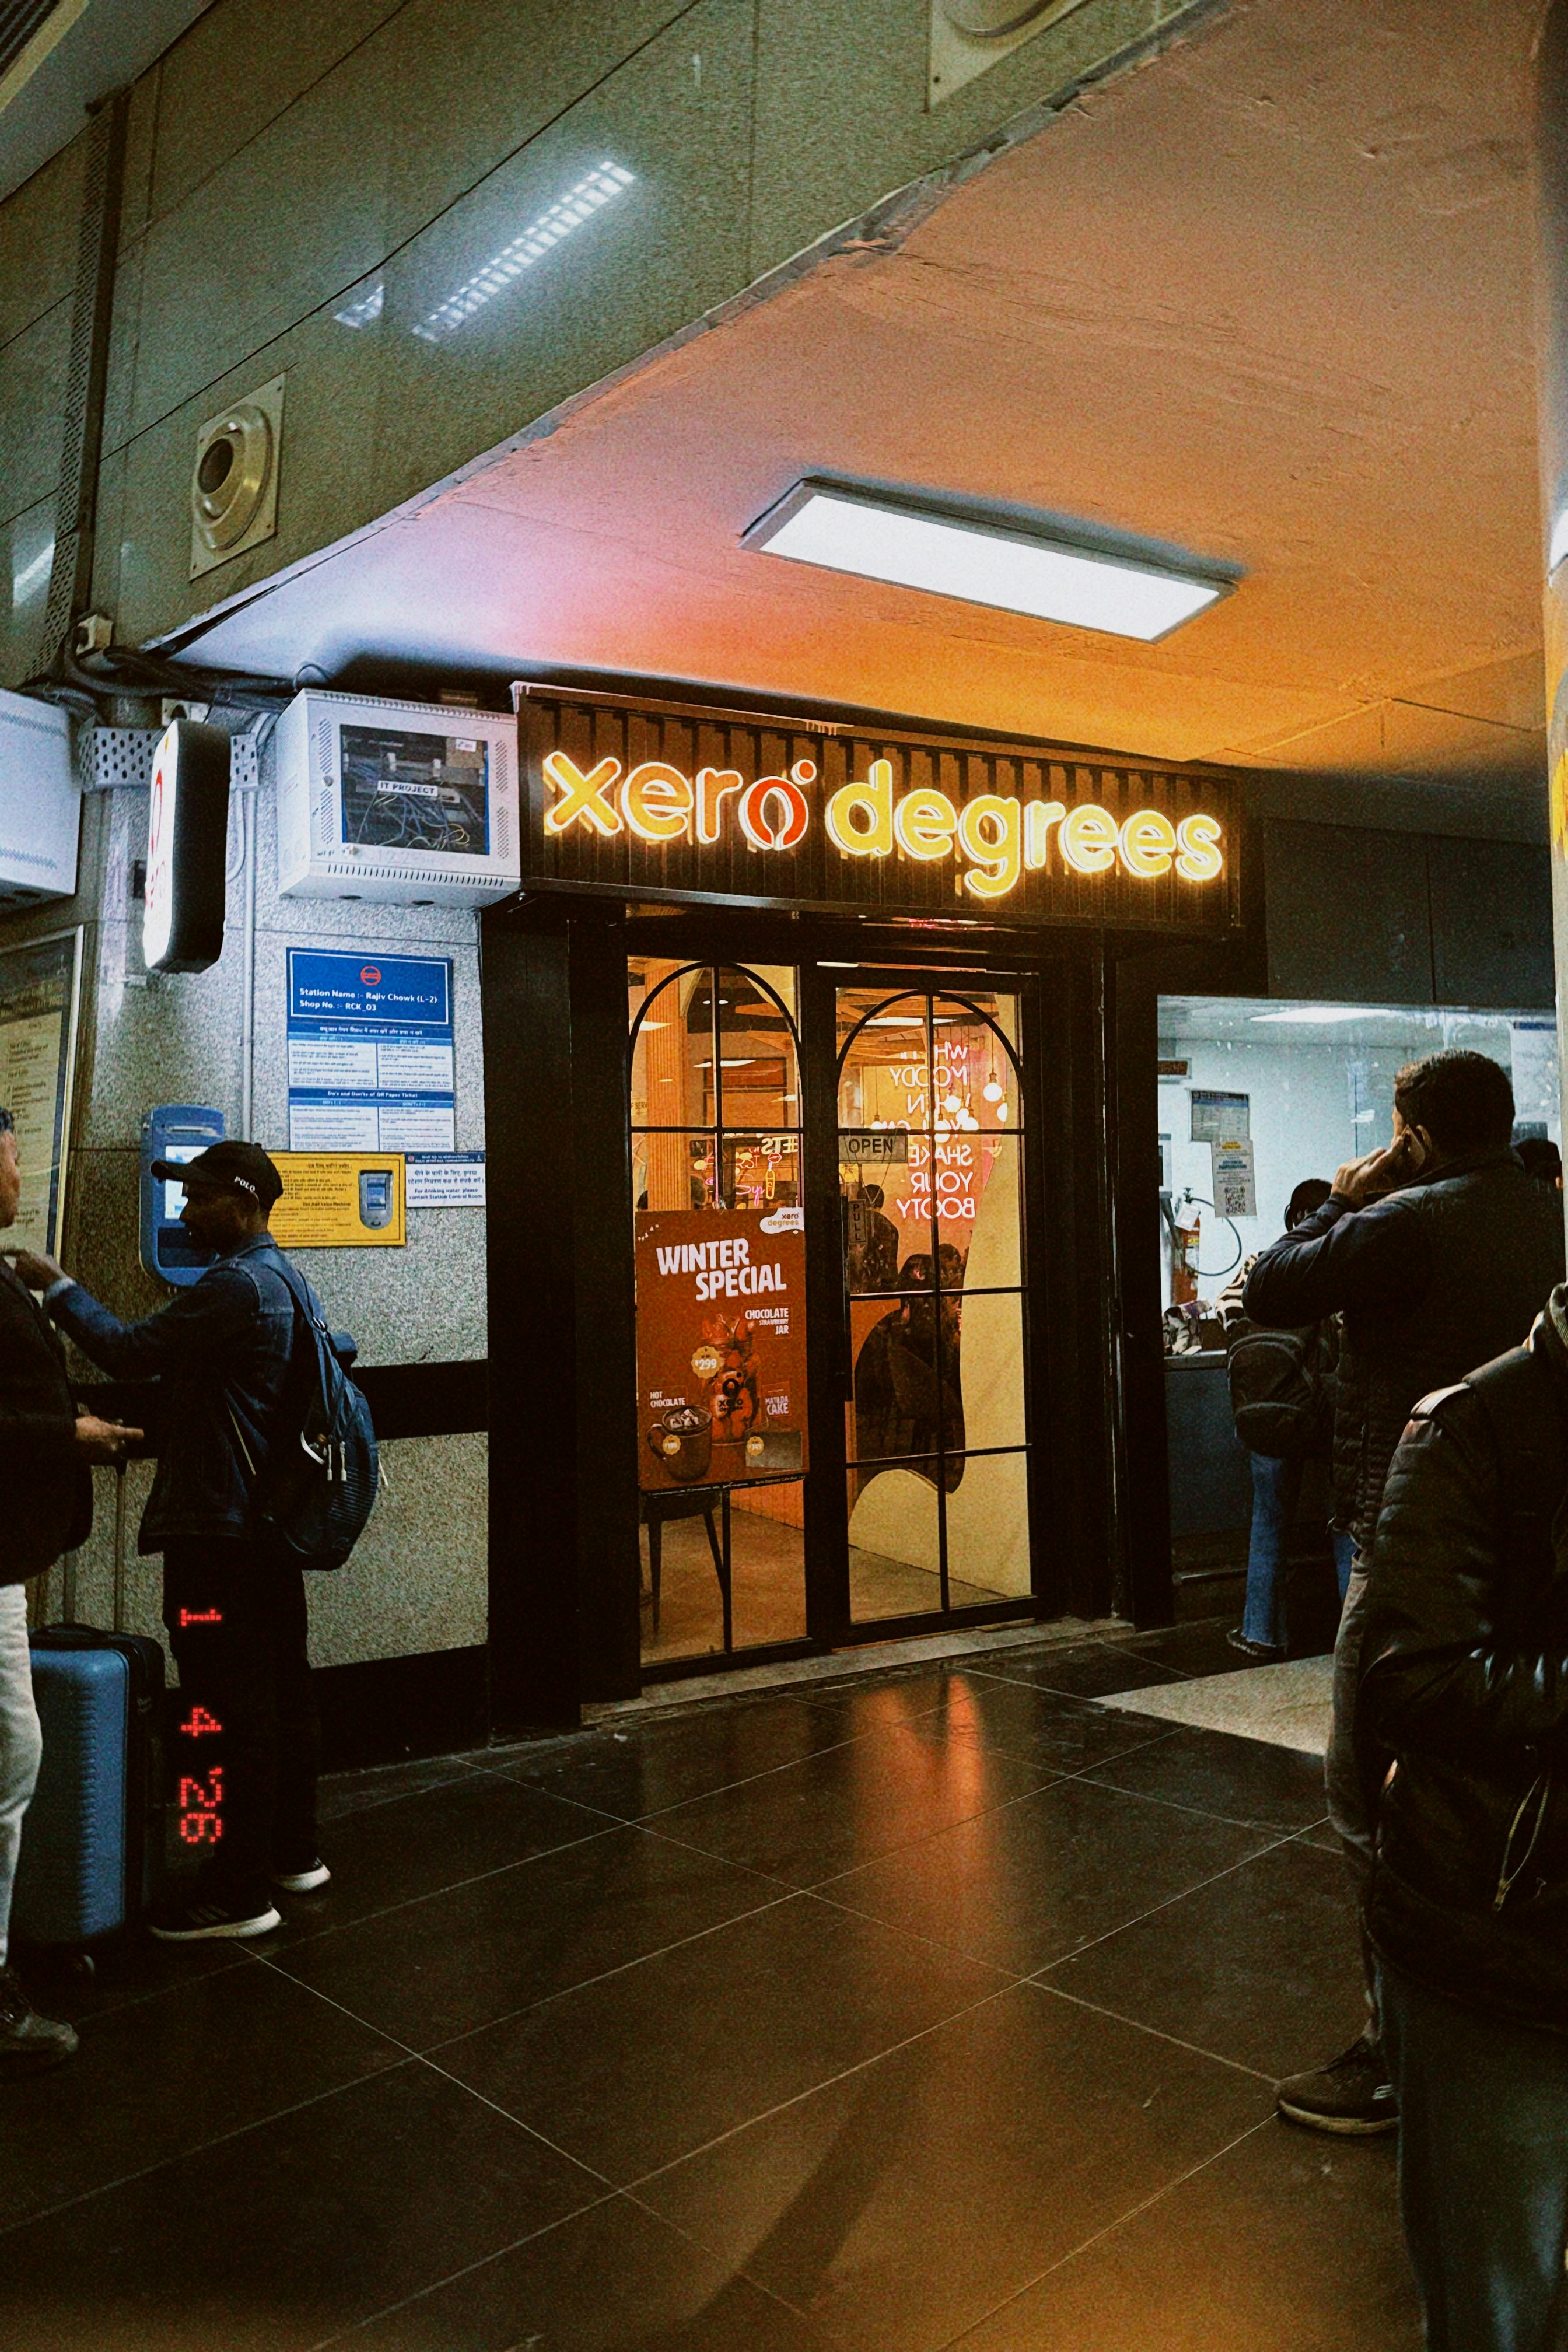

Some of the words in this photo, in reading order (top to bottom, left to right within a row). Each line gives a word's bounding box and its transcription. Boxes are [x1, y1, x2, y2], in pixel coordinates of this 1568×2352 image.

[392, 785, 435, 794] PROJECT
[825, 758, 1223, 897] degrees
[299, 988, 330, 996] Station
[366, 993, 386, 1002] Rajiv
[387, 994, 415, 1002] Chowk
[417, 995, 438, 1004] (L-2)
[299, 1000, 320, 1009] Shop
[345, 1003, 376, 1012] RCK_03
[848, 1138, 894, 1154] OPEN
[234, 1176, 256, 1193] POLO
[768, 1219, 799, 1228] degrees
[853, 1203, 862, 1242] PULL
[656, 1238, 750, 1276] WINTER
[695, 1263, 787, 1301] SPECIAL
[745, 1307, 789, 1320] CHOCOLATE
[775, 1325, 789, 1335] JAR
[650, 1391, 663, 1399] HOT
[765, 1395, 789, 1405] MATILDA
[650, 1398, 685, 1408] CHOCOLATE
[767, 1403, 789, 1415] CAKE
